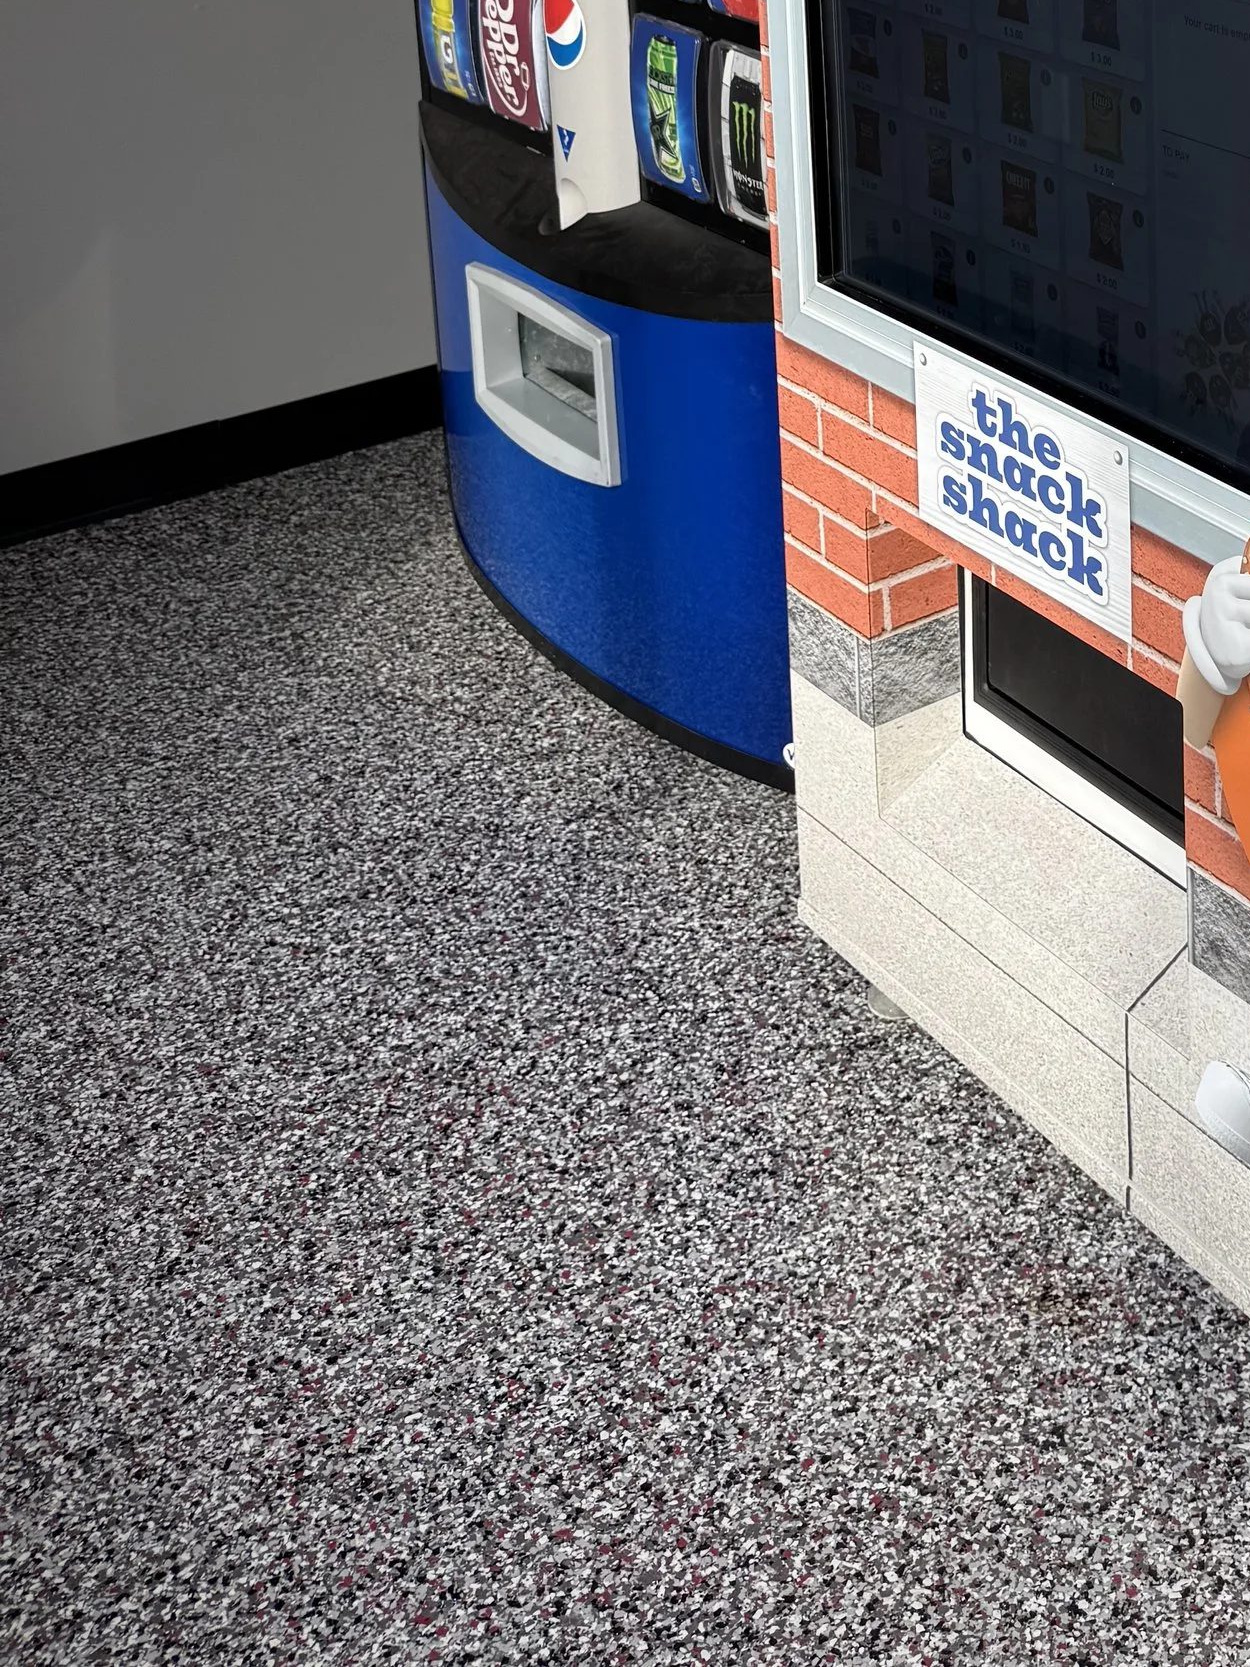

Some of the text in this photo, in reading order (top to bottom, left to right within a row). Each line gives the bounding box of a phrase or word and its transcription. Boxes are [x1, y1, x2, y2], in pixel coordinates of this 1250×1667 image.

[940, 421, 1103, 538] snack
[971, 389, 1061, 470] the
[942, 473, 1104, 597] shack
